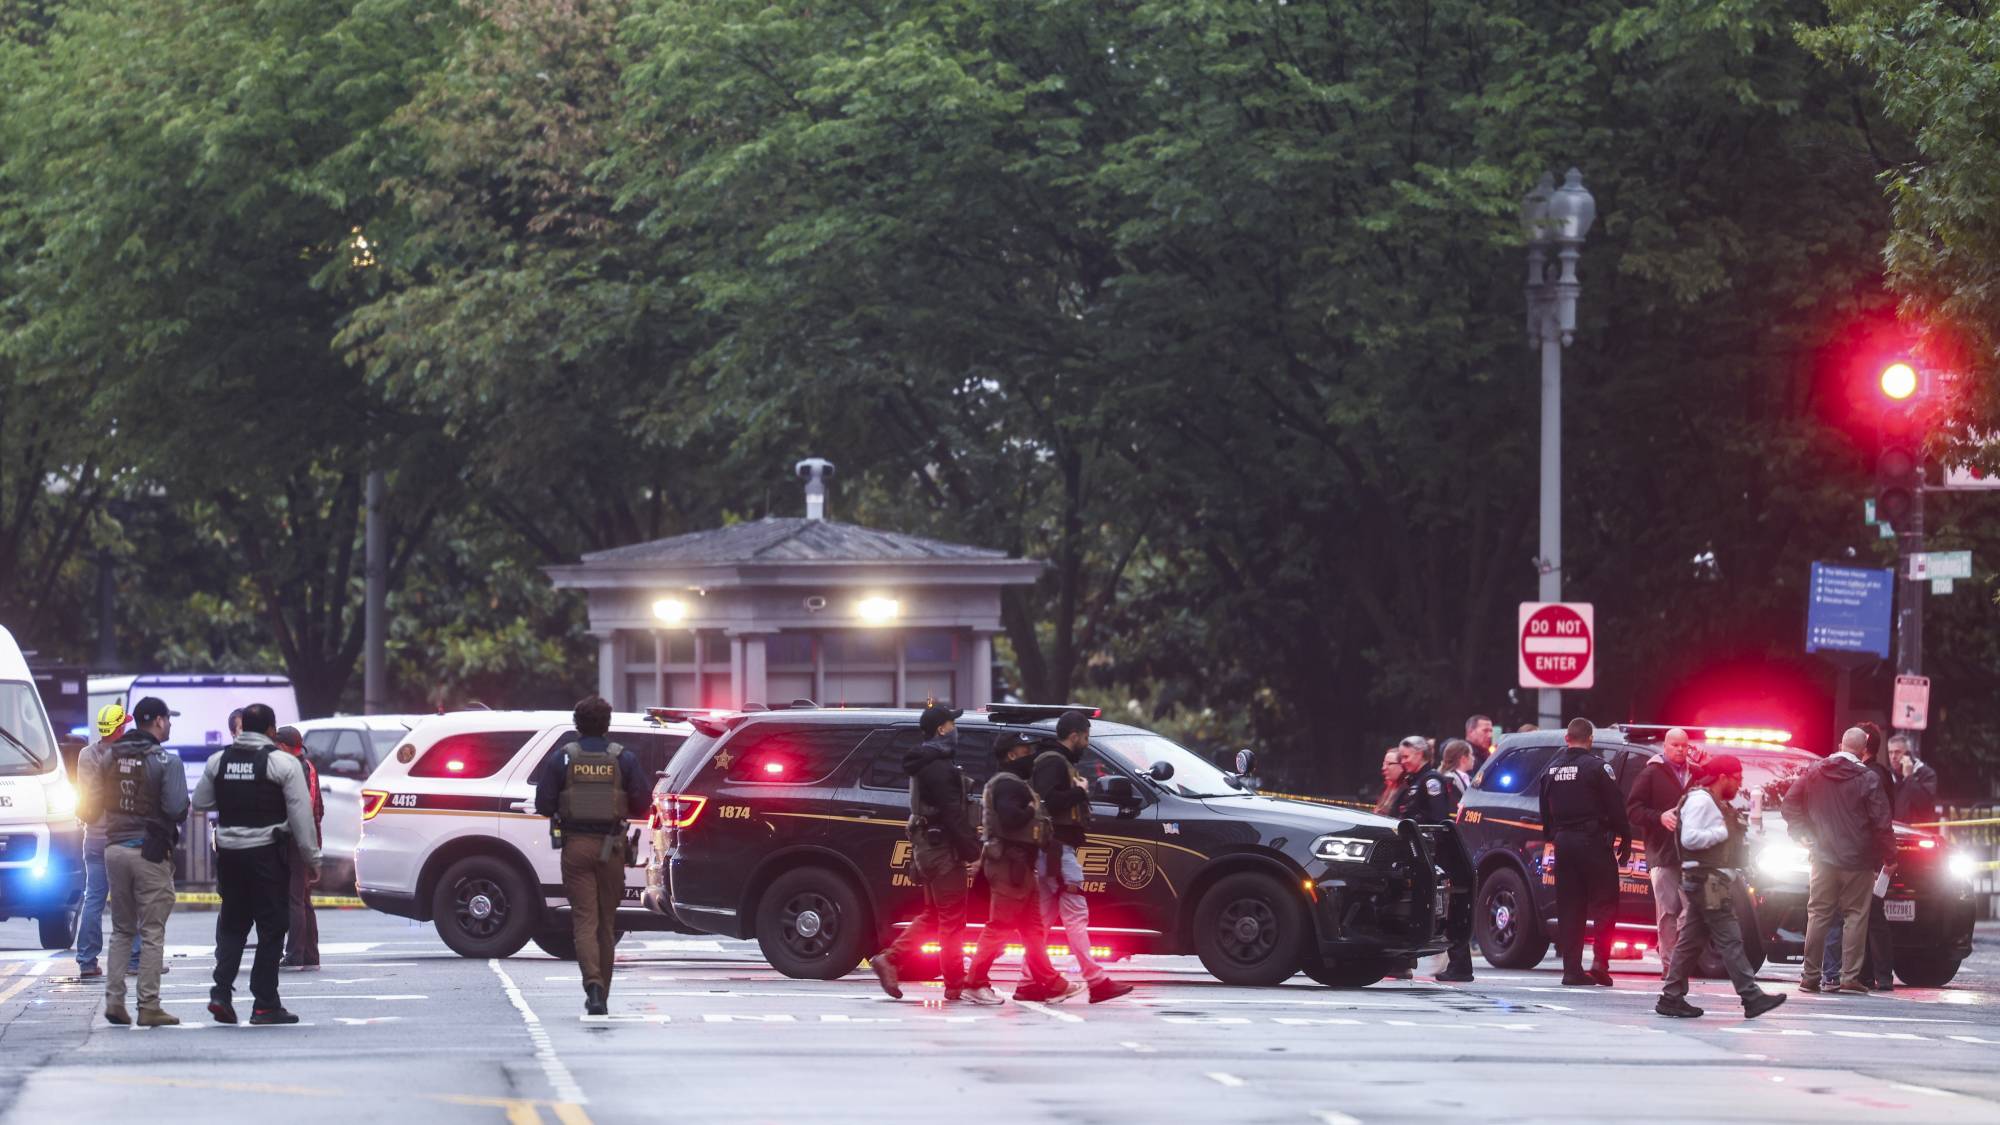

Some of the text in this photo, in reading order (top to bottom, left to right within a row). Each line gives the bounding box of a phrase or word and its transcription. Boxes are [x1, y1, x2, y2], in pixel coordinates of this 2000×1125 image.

[1531, 620, 1581, 635] DO NOT
[1536, 656, 1576, 670] ENTER
[226, 762, 254, 774] POLICE
[574, 764, 614, 776] POLICE
[1554, 773, 1577, 782] OLICE
[391, 794, 417, 807] 4413
[718, 805, 751, 819] 1874
[1465, 810, 1482, 824] 2981
